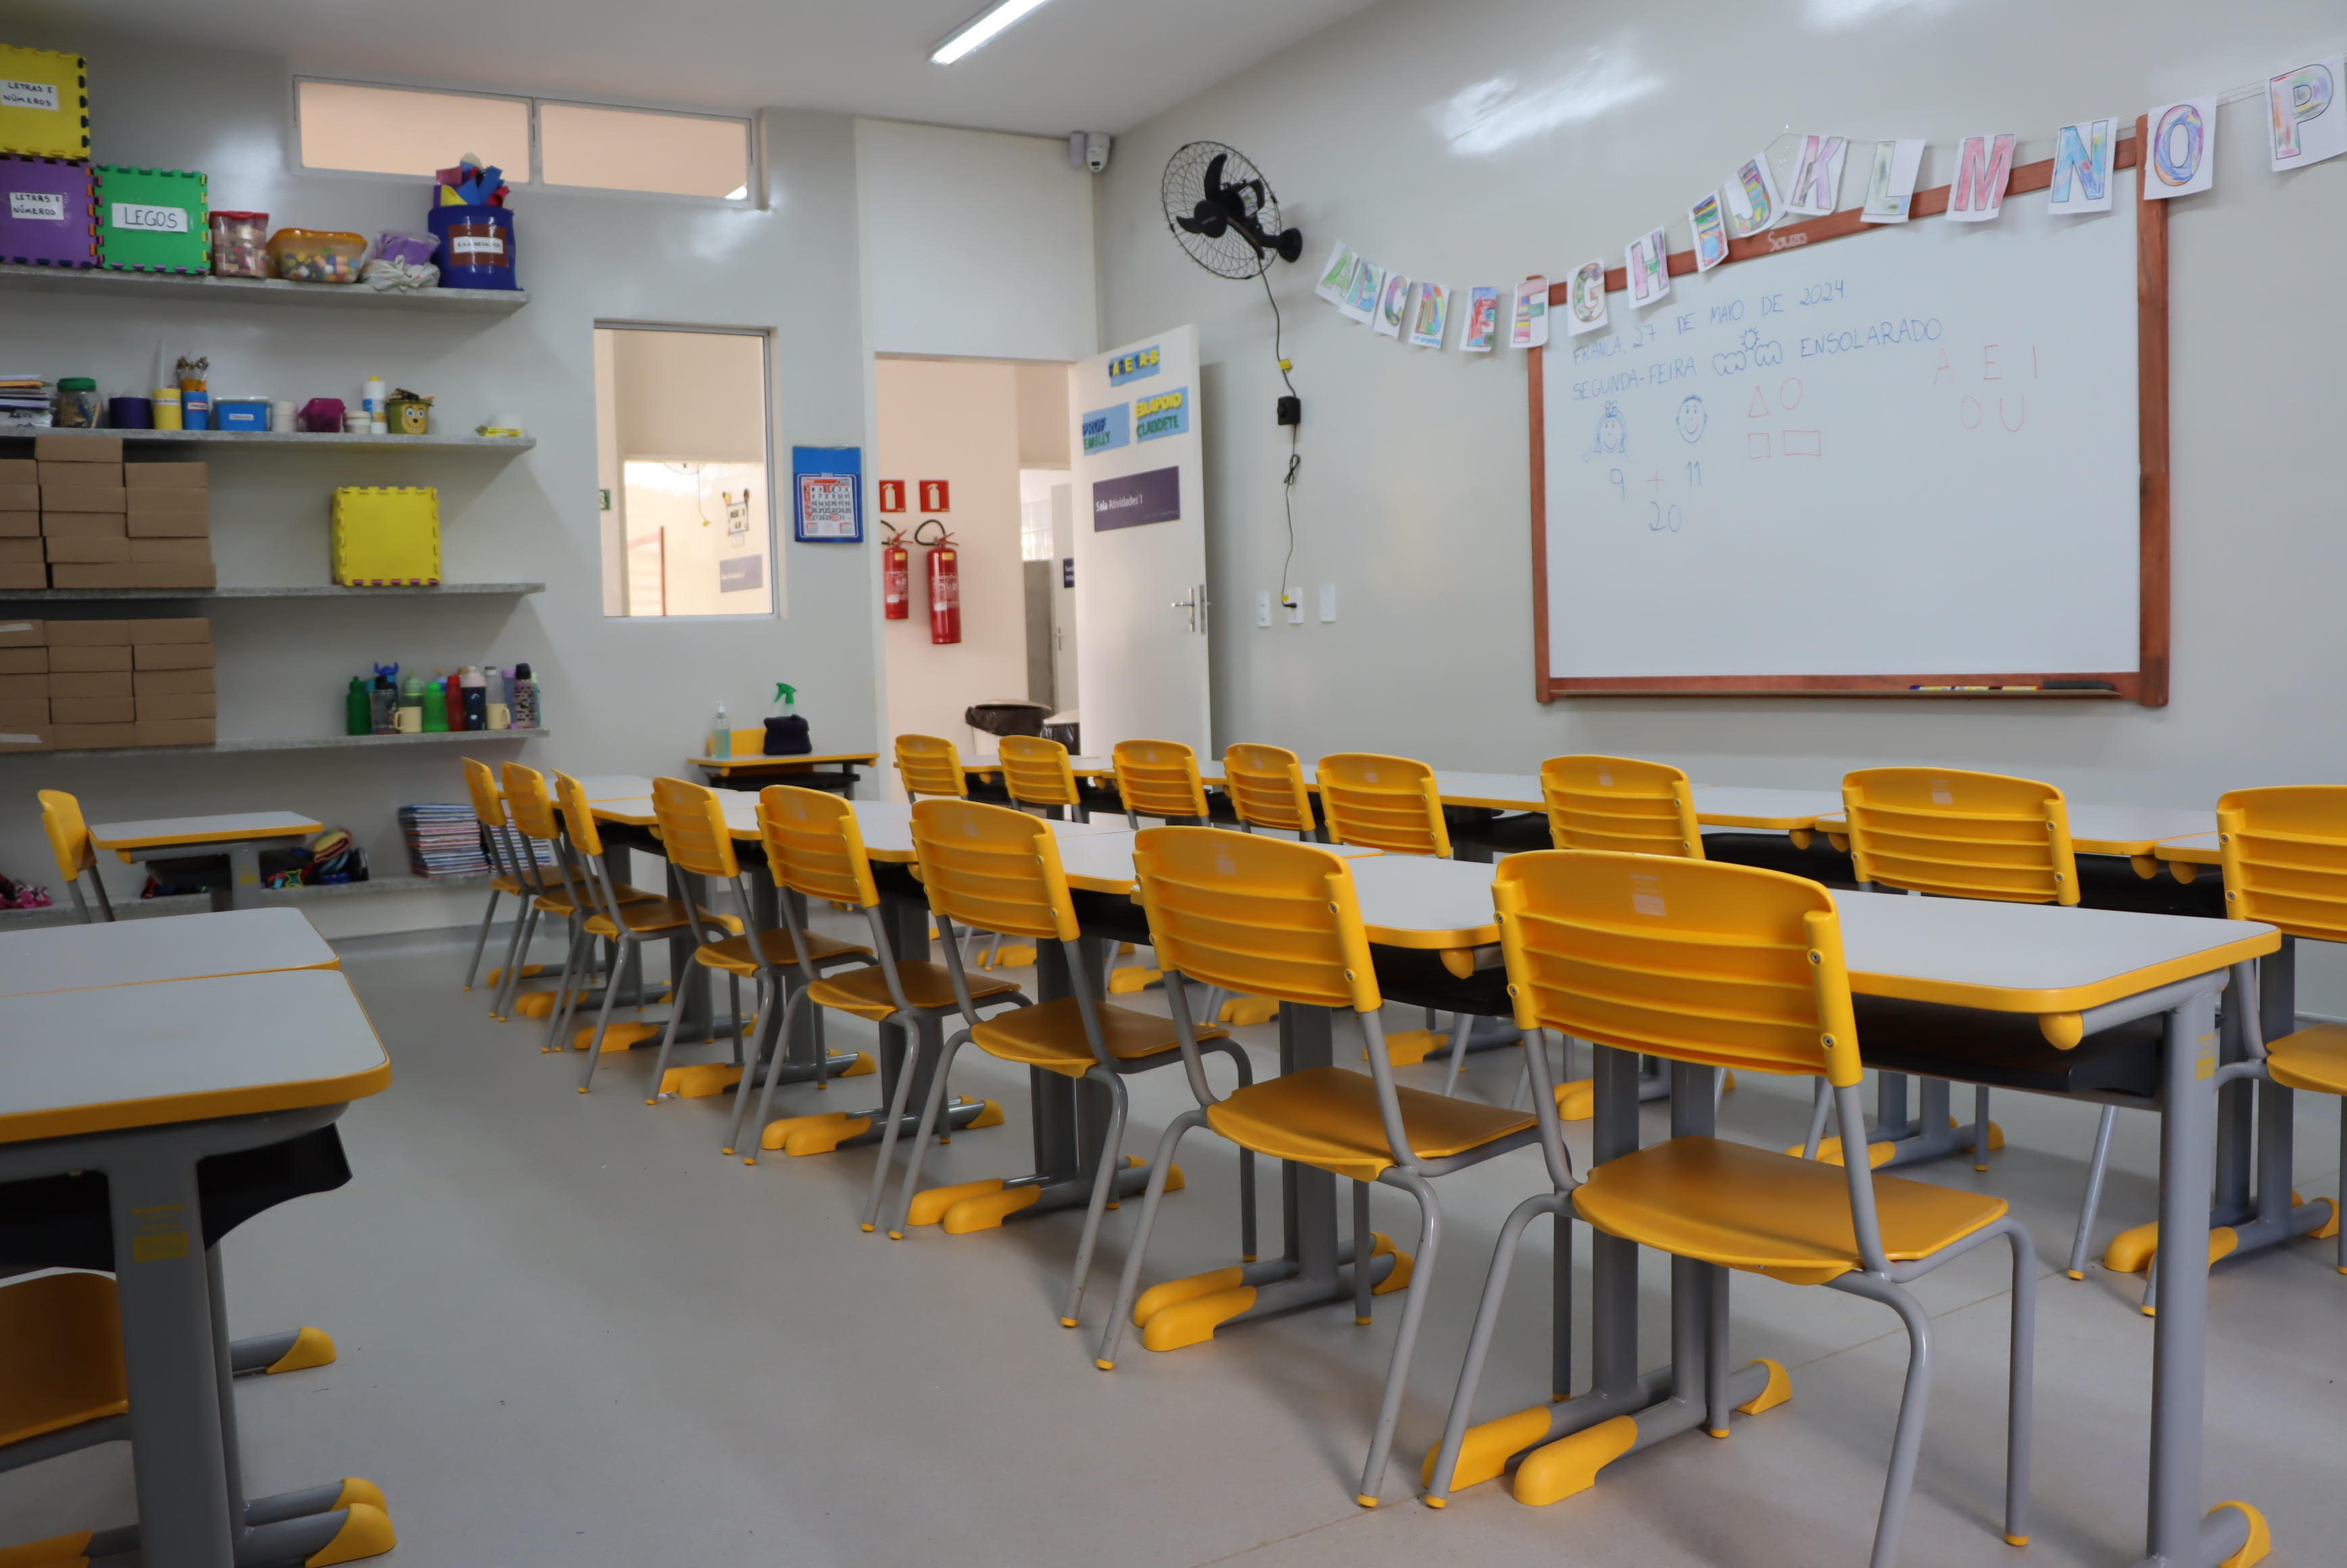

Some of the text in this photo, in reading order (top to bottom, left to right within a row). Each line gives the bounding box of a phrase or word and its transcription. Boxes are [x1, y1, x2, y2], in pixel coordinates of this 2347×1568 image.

[7, 81, 43, 93] LETRAS
[14, 204, 56, 216] NÚMEROS
[15, 193, 51, 203] LETRAS
[1322, 64, 2334, 347] A B C D E F G H I J K L M N O P
[124, 206, 178, 228] LEGOS
[1768, 230, 1808, 252] Souza
[1632, 324, 1657, 348] 27
[1677, 312, 1695, 335] DE
[1711, 299, 1745, 324] MAIO
[1762, 293, 1785, 316] DE
[1799, 279, 1845, 305] 2024
[1572, 318, 1942, 400] SEGUNDA-FEIRA ENSOLARADO
[1933, 347, 1956, 385] A
[1983, 344, 2002, 381] E
[1960, 393, 2025, 432] O U
[1082, 416, 1107, 437] PROF
[1136, 414, 1180, 439] CLAUDETE
[1610, 468, 1626, 501] 9
[1686, 461, 1701, 487] 11
[1096, 499, 1108, 512] Sala
[1109, 495, 1138, 510] Atividades
[1649, 501, 1682, 533] 20
